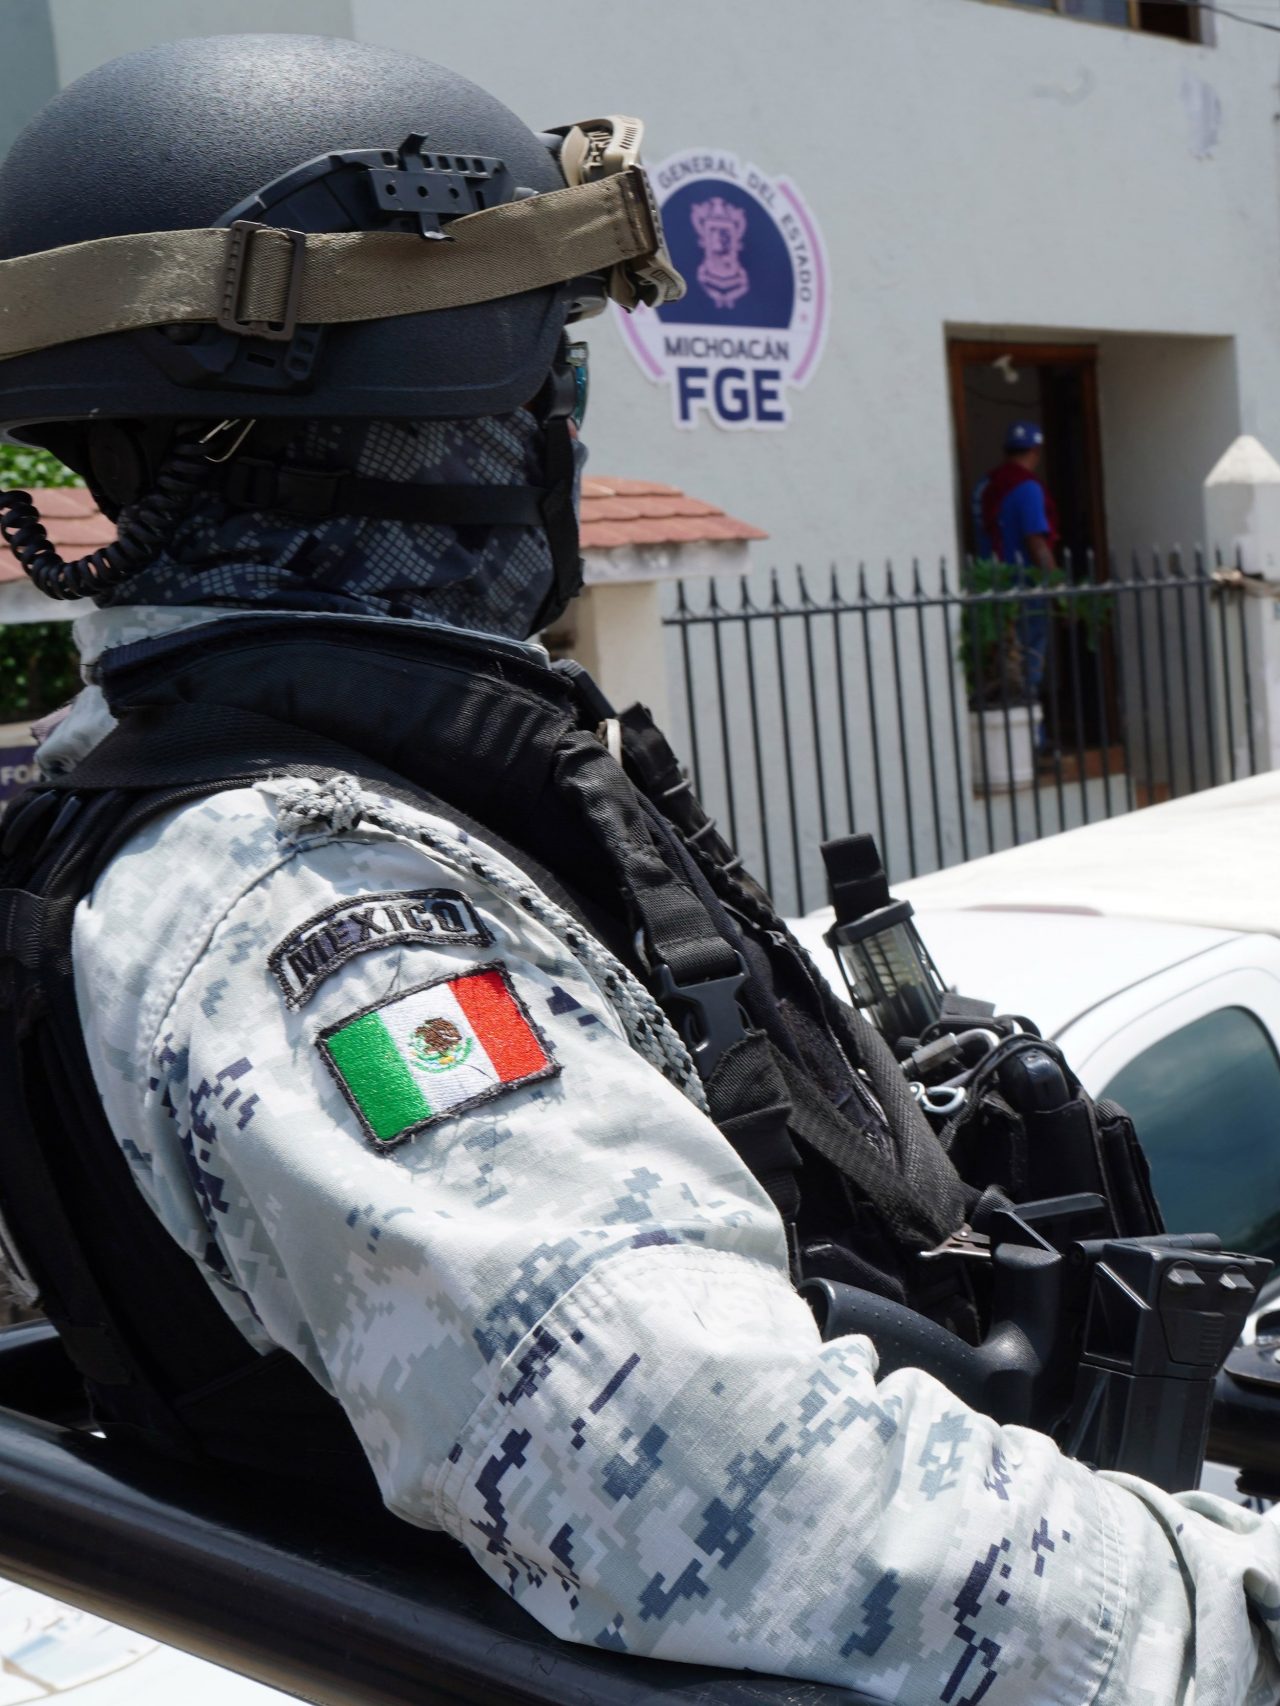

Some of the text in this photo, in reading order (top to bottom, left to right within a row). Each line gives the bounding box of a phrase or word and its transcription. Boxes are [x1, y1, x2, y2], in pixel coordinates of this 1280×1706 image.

[658, 156, 812, 303] GENERAL DEL ESTADO
[664, 335, 790, 361] MICHOACÁN
[676, 366, 786, 423] FGE
[287, 900, 468, 985] MEXICO
